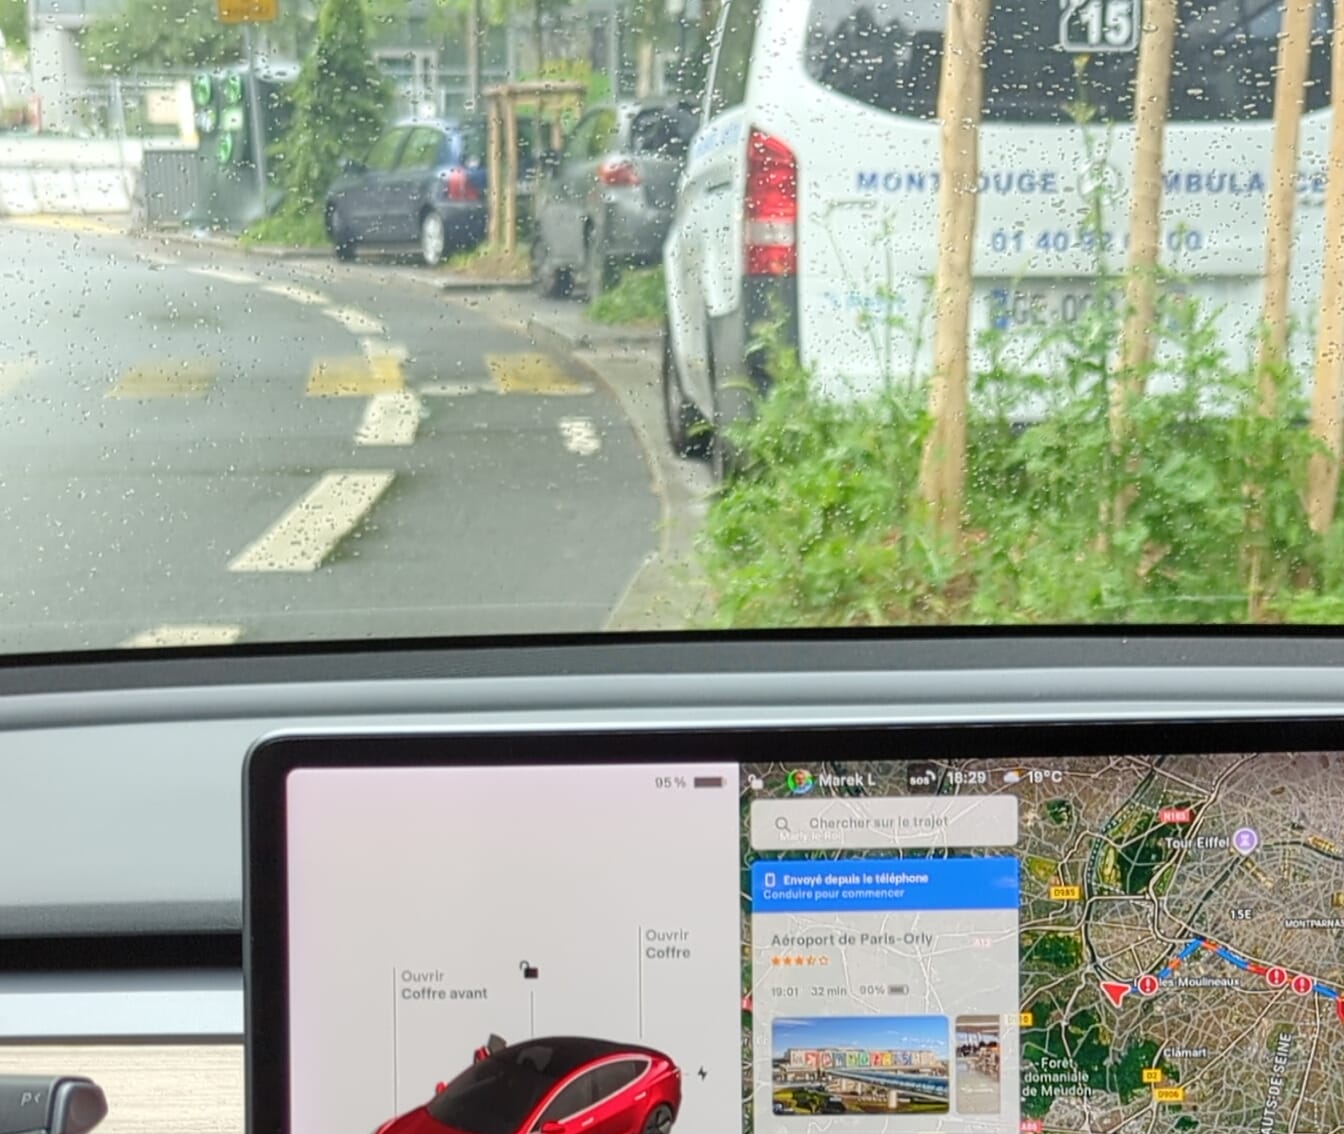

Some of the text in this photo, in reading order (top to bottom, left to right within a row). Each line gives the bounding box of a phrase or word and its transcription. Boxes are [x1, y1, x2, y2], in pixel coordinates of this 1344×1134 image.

[1079, 0, 1131, 45] 15
[858, 171, 1057, 194] MONTOUGE
[991, 231, 1023, 253] 01
[1036, 231, 1069, 253] 40
[819, 773, 876, 788] Marek L
[947, 771, 987, 785] 18:29
[1027, 770, 1064, 784] 19°C
[809, 814, 949, 830] Chercher sur le trajet
[1166, 836, 1230, 848] Tour Eiffel
[783, 872, 930, 888] Envoyé depuis le téléphone
[763, 888, 905, 901] Conduire pour commencer
[645, 928, 690, 942] Ouvrir
[771, 931, 934, 948] Aéroport de Paris-Orly
[645, 946, 691, 960] Coffre
[401, 969, 445, 983] Ouvrir
[401, 987, 489, 1000] Coffre avant
[827, 985, 847, 997] min
[1163, 1048, 1207, 1058] Clamart
[1041, 1057, 1074, 1070] Forêt
[1024, 1071, 1089, 1083] domaniale
[1022, 1085, 1092, 1097] de Meudon
